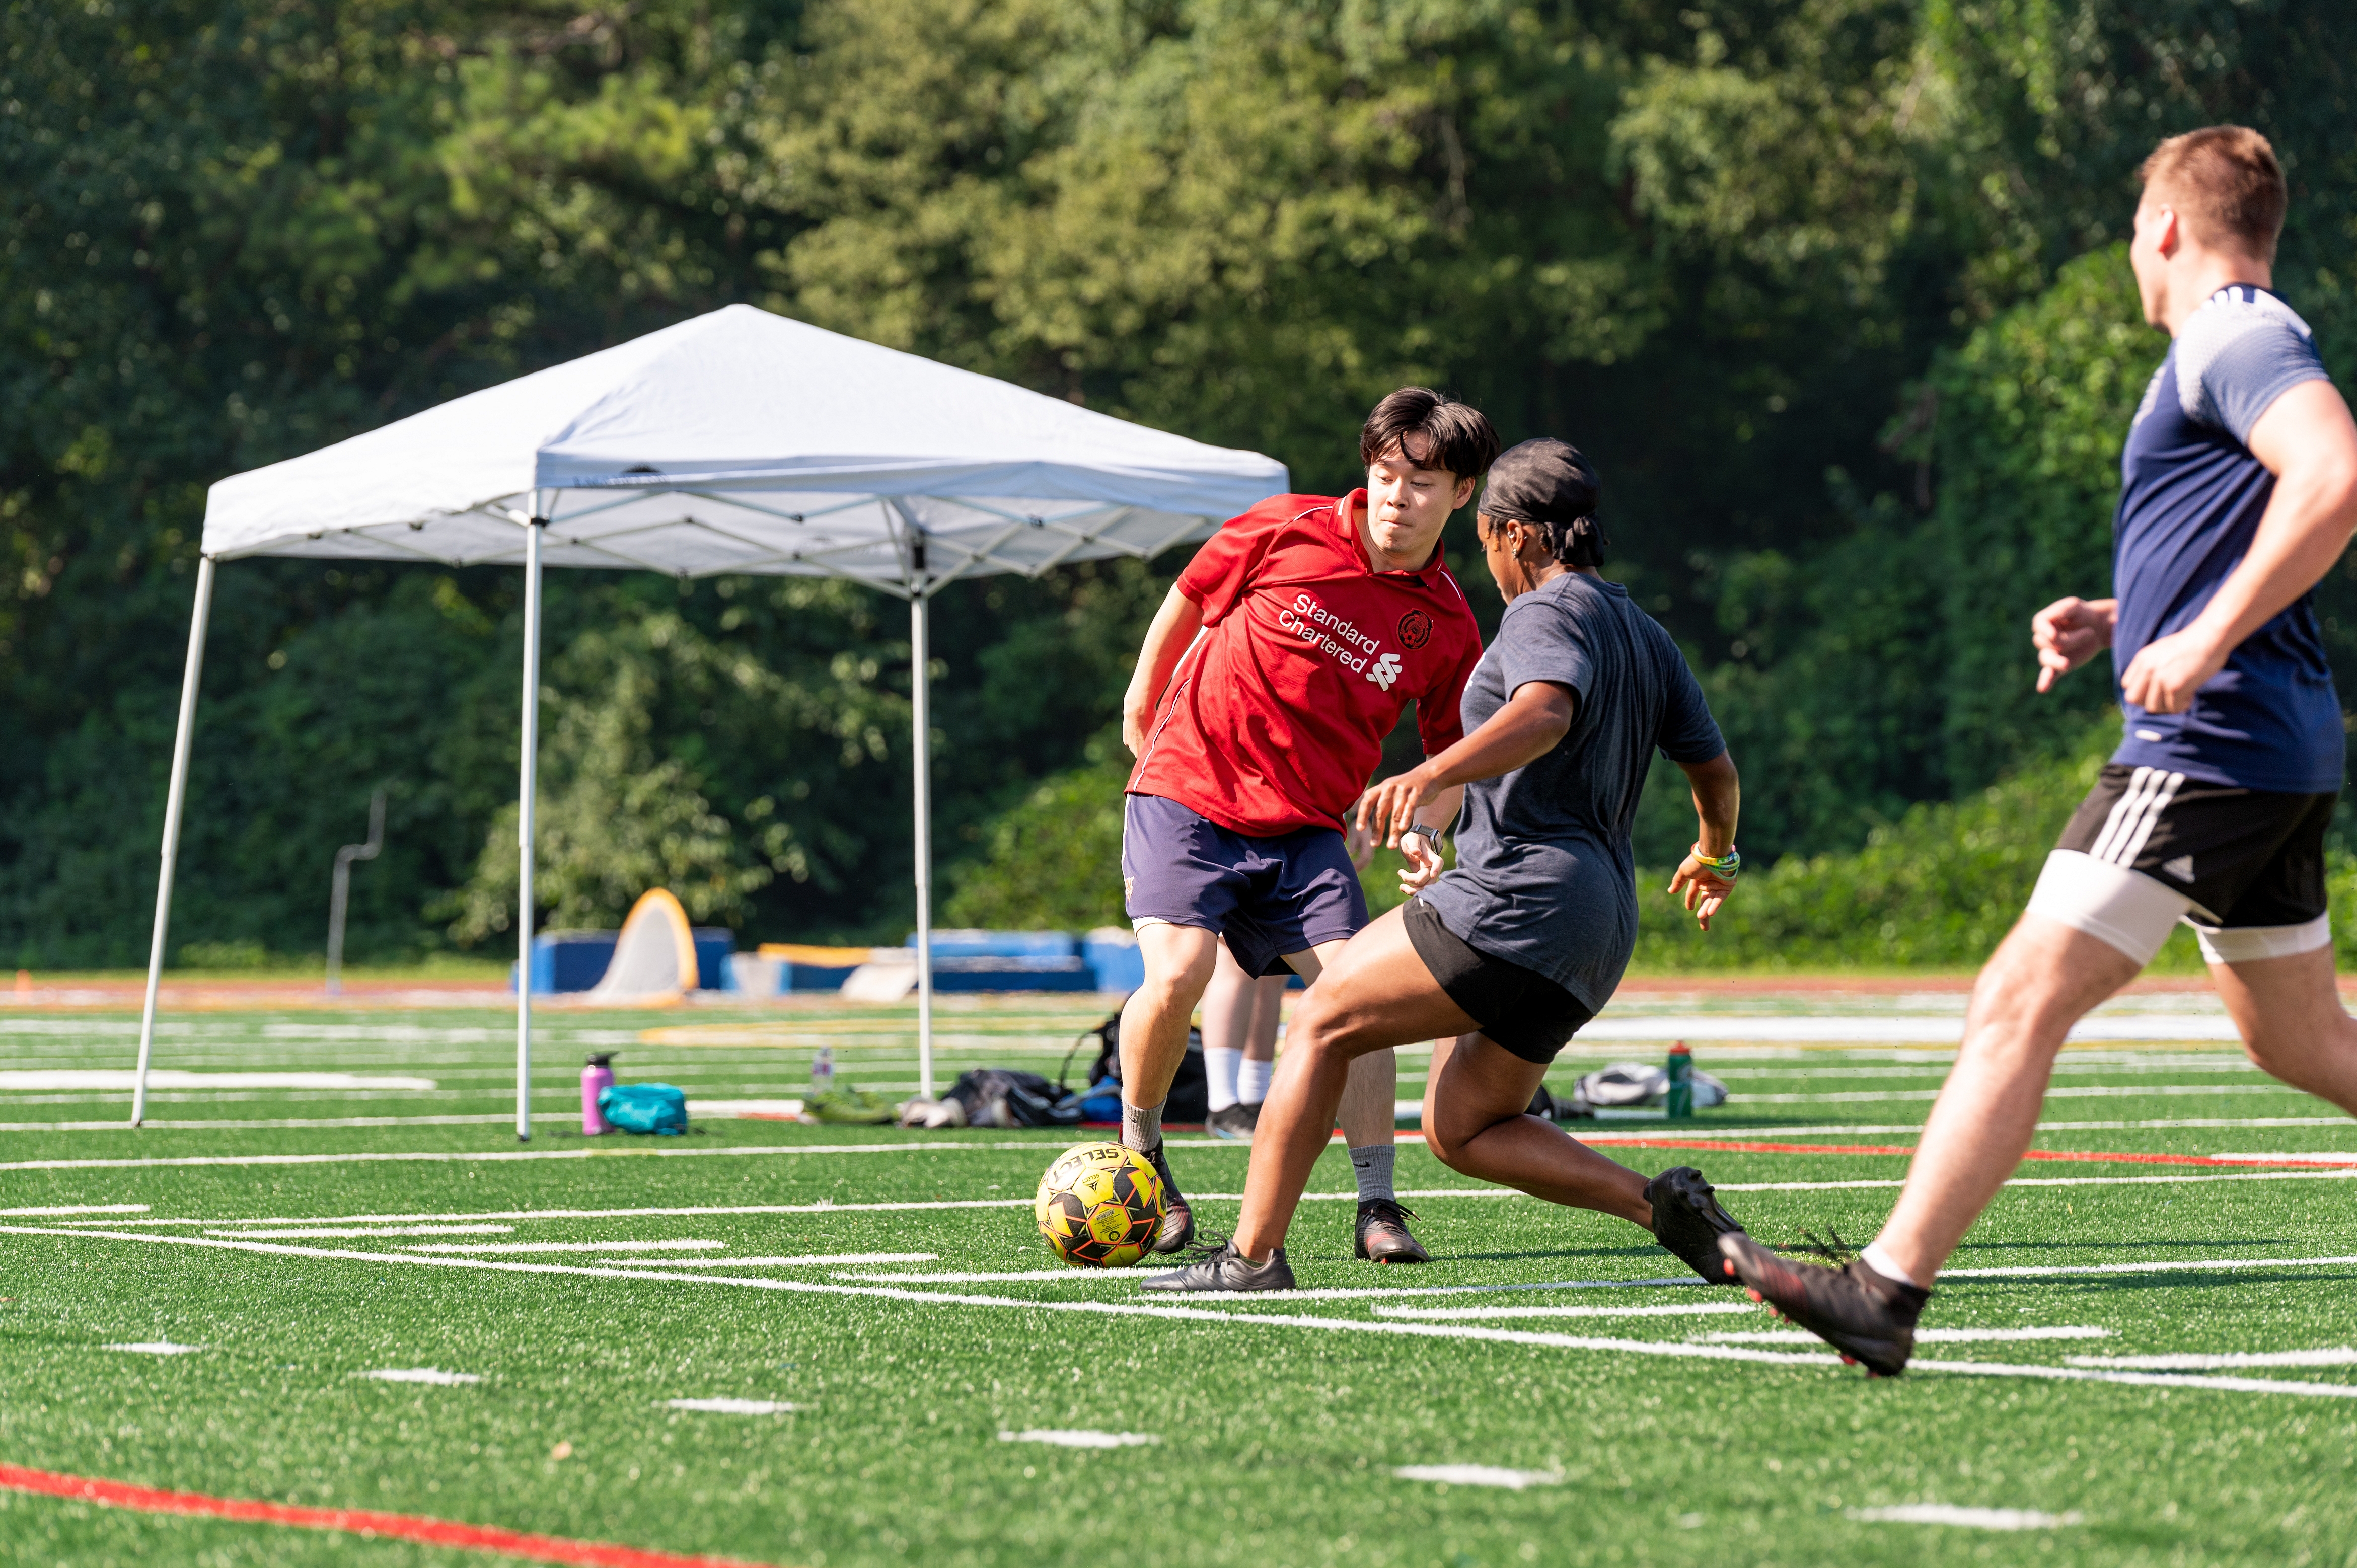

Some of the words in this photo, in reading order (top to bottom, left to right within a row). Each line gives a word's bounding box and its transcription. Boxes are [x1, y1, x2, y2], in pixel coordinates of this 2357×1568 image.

[1279, 610, 1368, 673] Chartered
[1293, 594, 1380, 655] Standard
[1053, 1148, 1119, 1183] SELECT
[1082, 1173, 1099, 1183] SELECT
